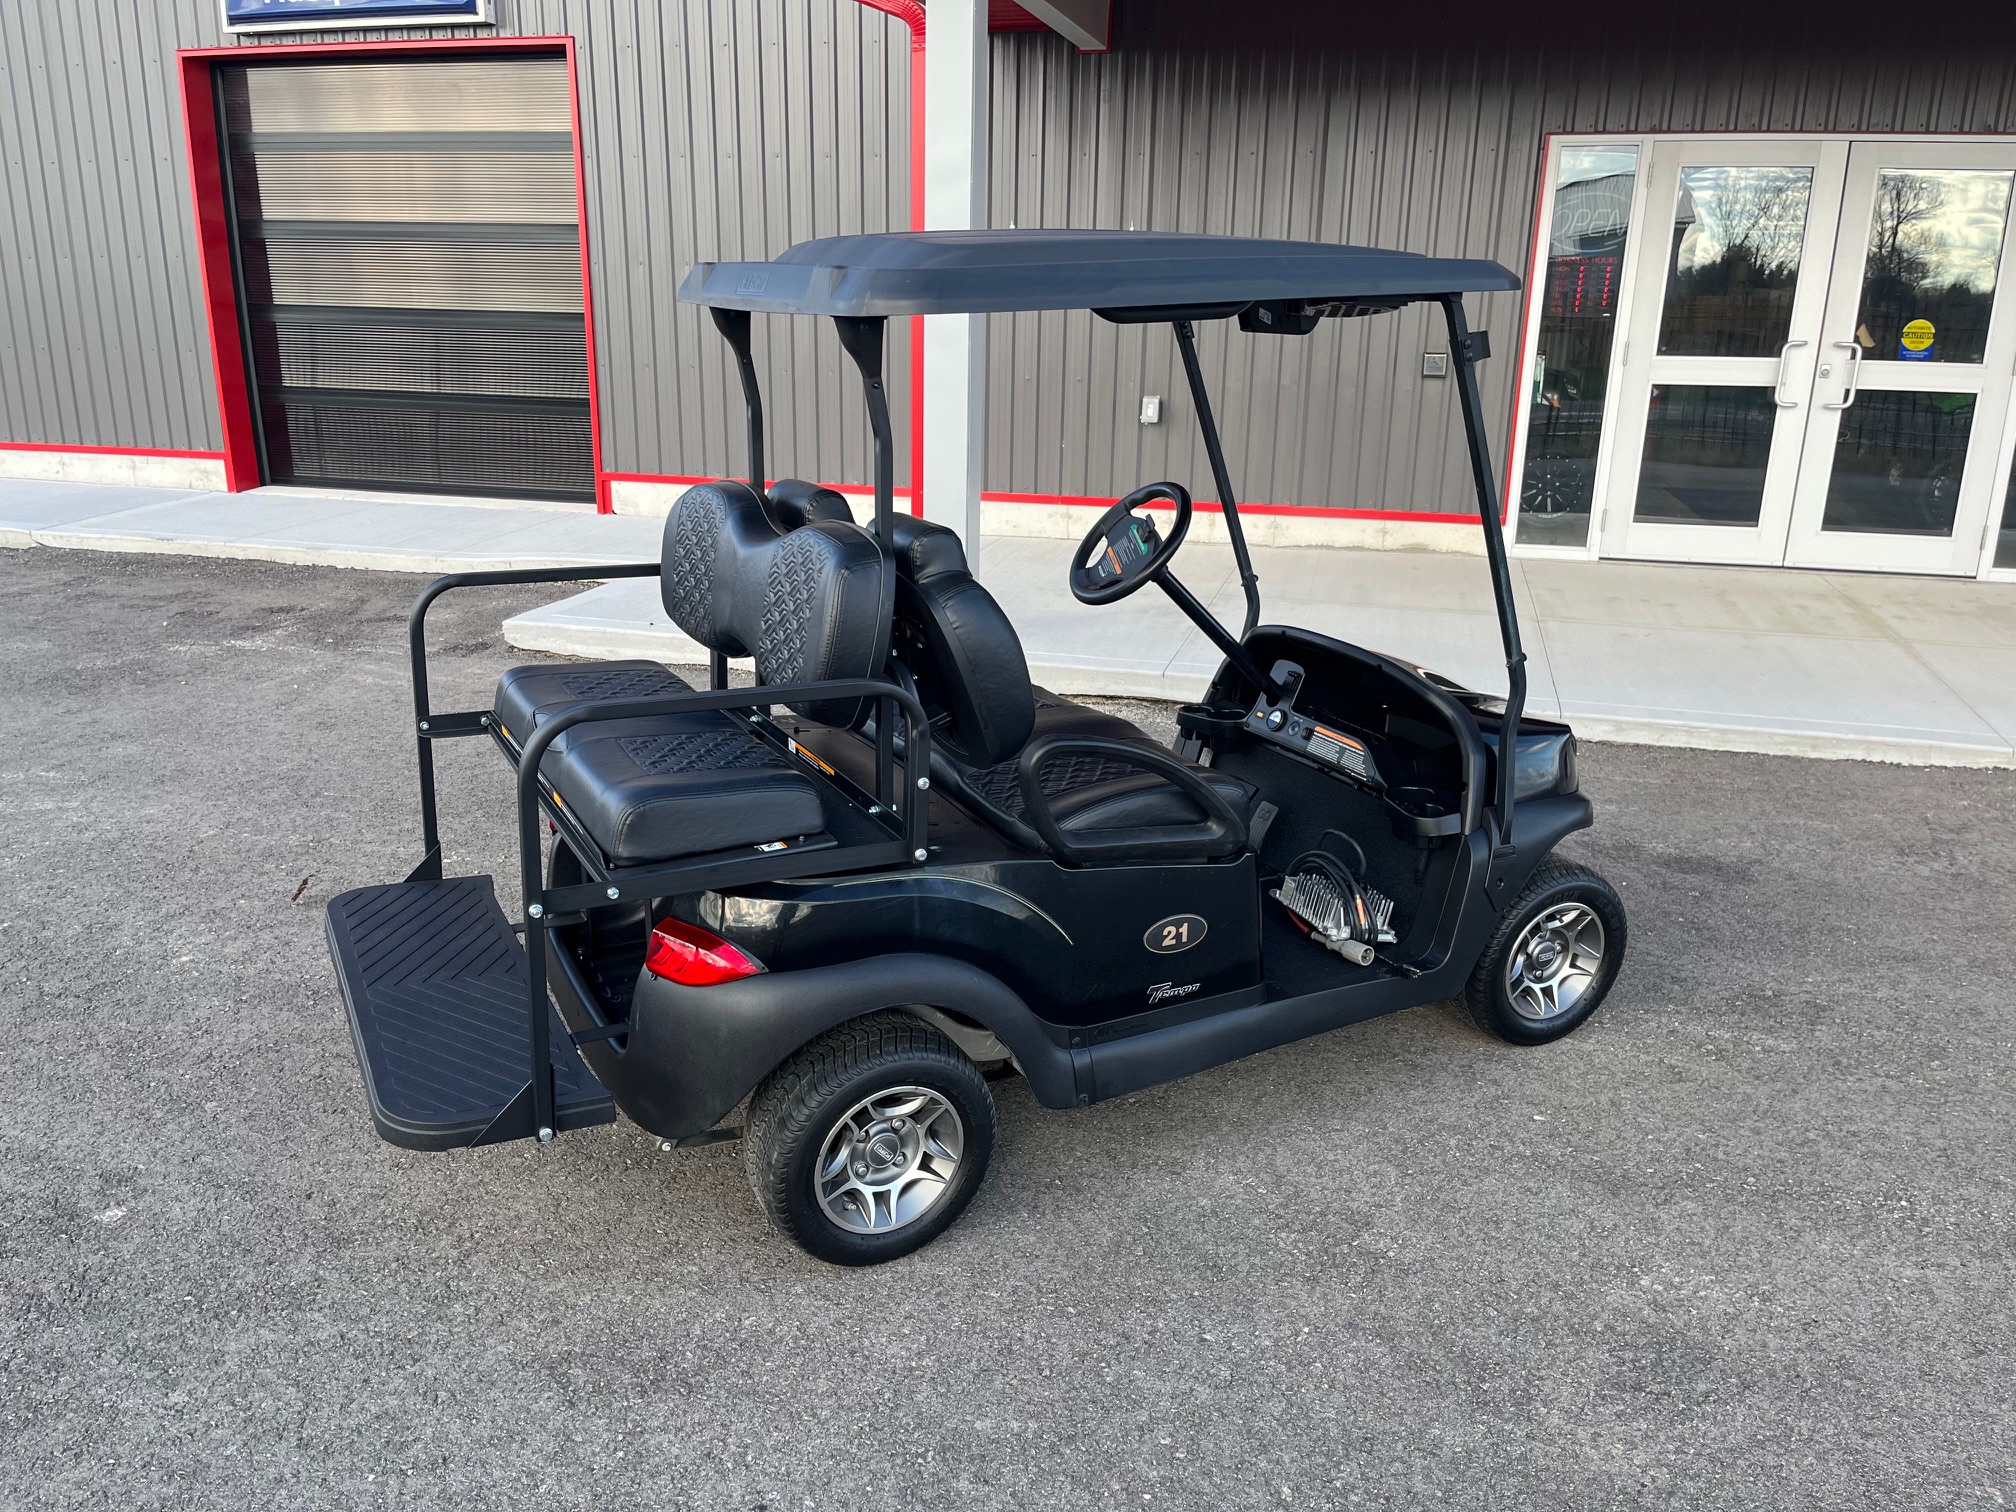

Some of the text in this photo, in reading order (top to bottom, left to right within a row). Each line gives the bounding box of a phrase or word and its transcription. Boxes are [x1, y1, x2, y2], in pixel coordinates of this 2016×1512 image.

[1553, 209, 1628, 236] OPEN
[1591, 256, 1618, 264] HOURS
[1161, 922, 1189, 947] 21
[1146, 981, 1201, 1004] Tempo
